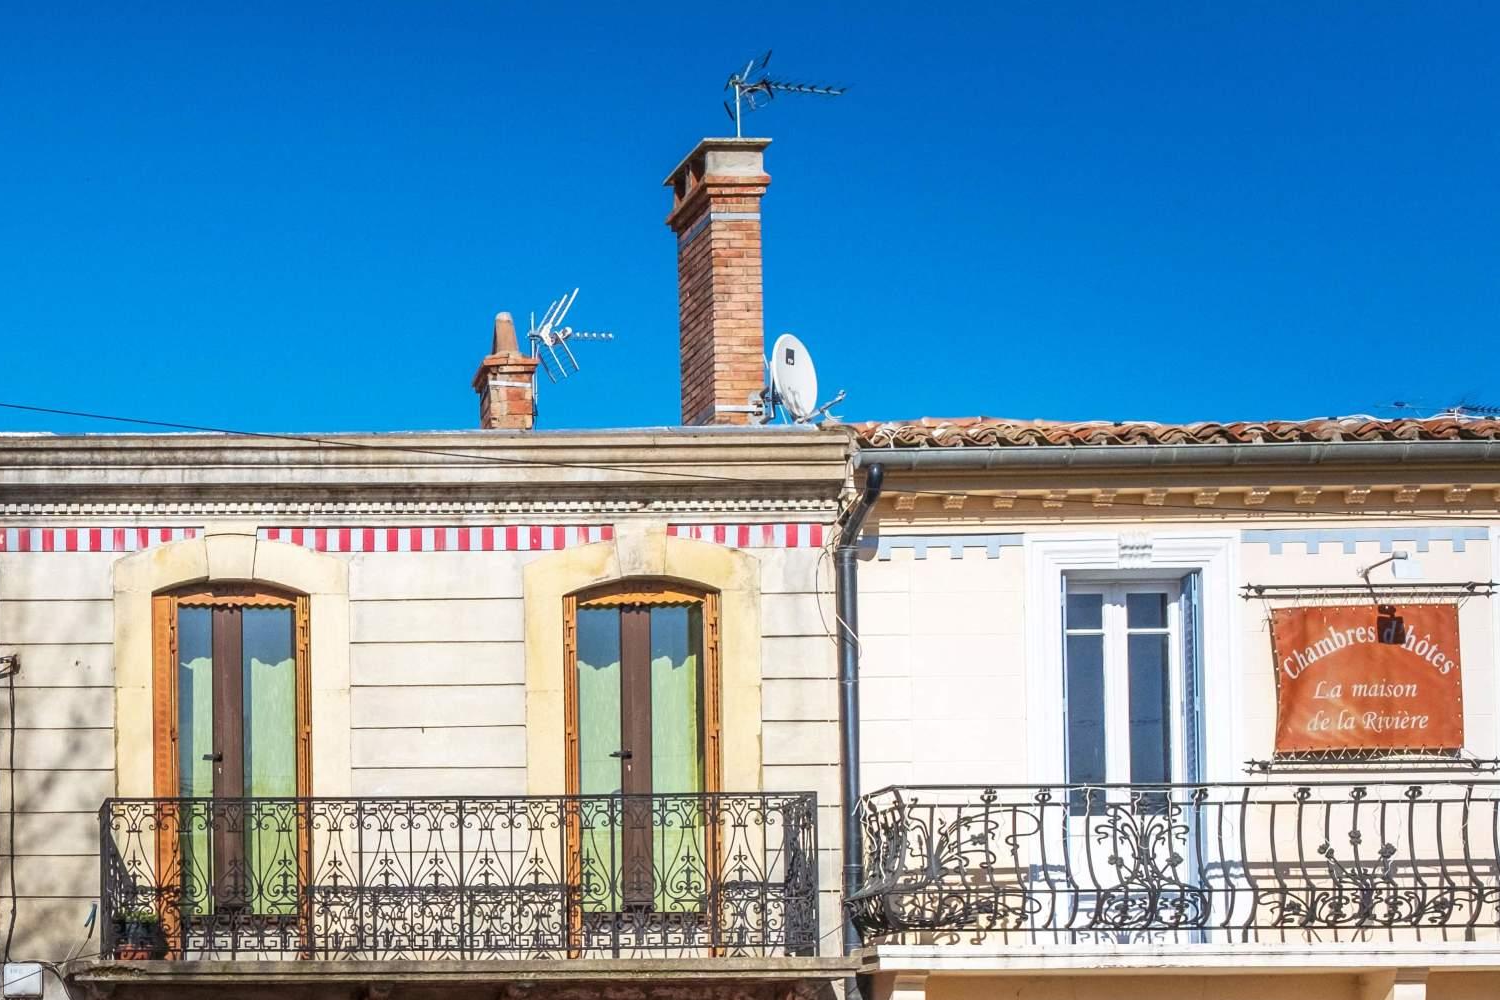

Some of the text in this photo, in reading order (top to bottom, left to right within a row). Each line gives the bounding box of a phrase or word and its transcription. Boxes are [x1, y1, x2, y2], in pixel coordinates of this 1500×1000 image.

[1283, 625, 1376, 681] Chambres
[1313, 678, 1418, 700] La maison
[1307, 709, 1429, 733] de la Rivière
